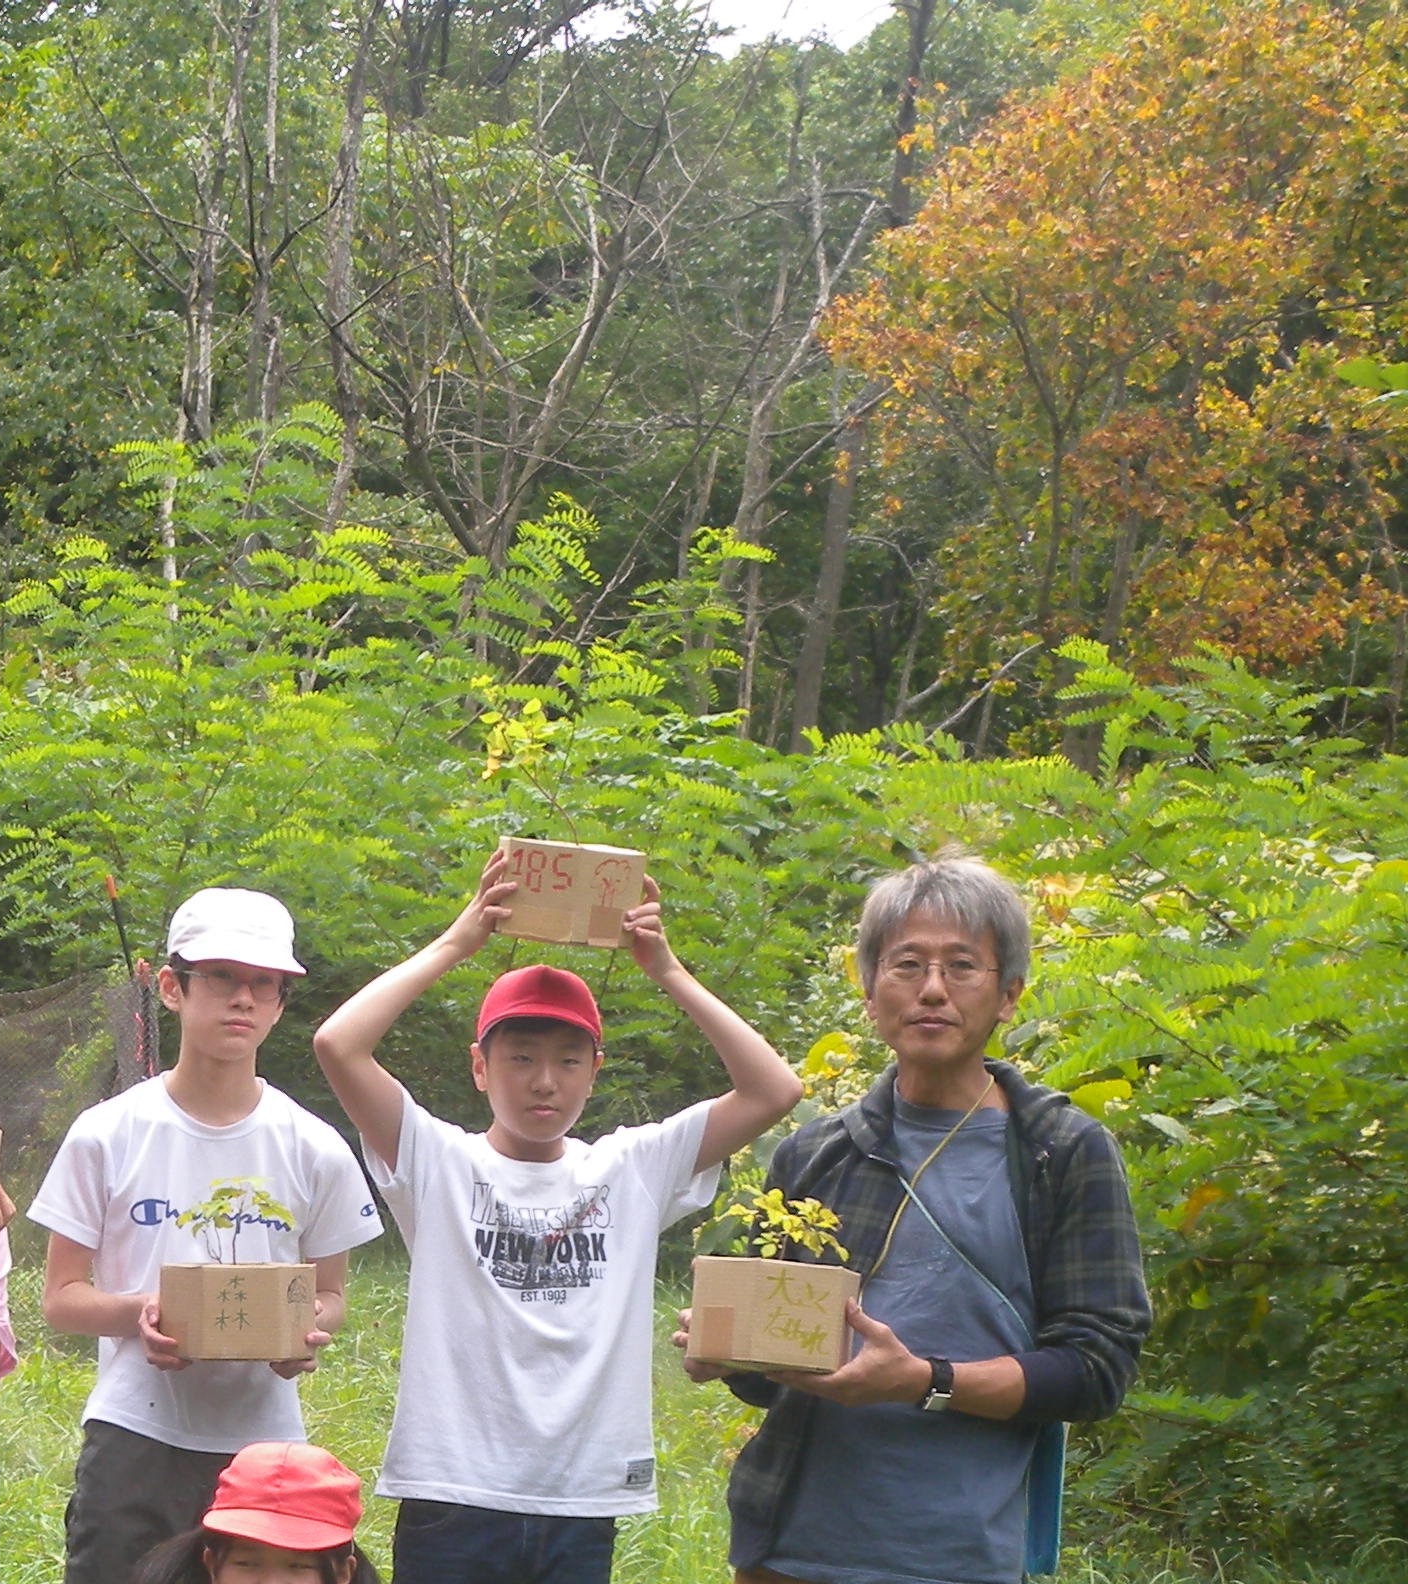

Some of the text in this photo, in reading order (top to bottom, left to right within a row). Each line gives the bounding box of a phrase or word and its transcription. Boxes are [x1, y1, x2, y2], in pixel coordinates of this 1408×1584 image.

[511, 849, 573, 893] 185
[475, 1228, 607, 1264] NEW YORK
[542, 1290, 567, 1301] 1903
